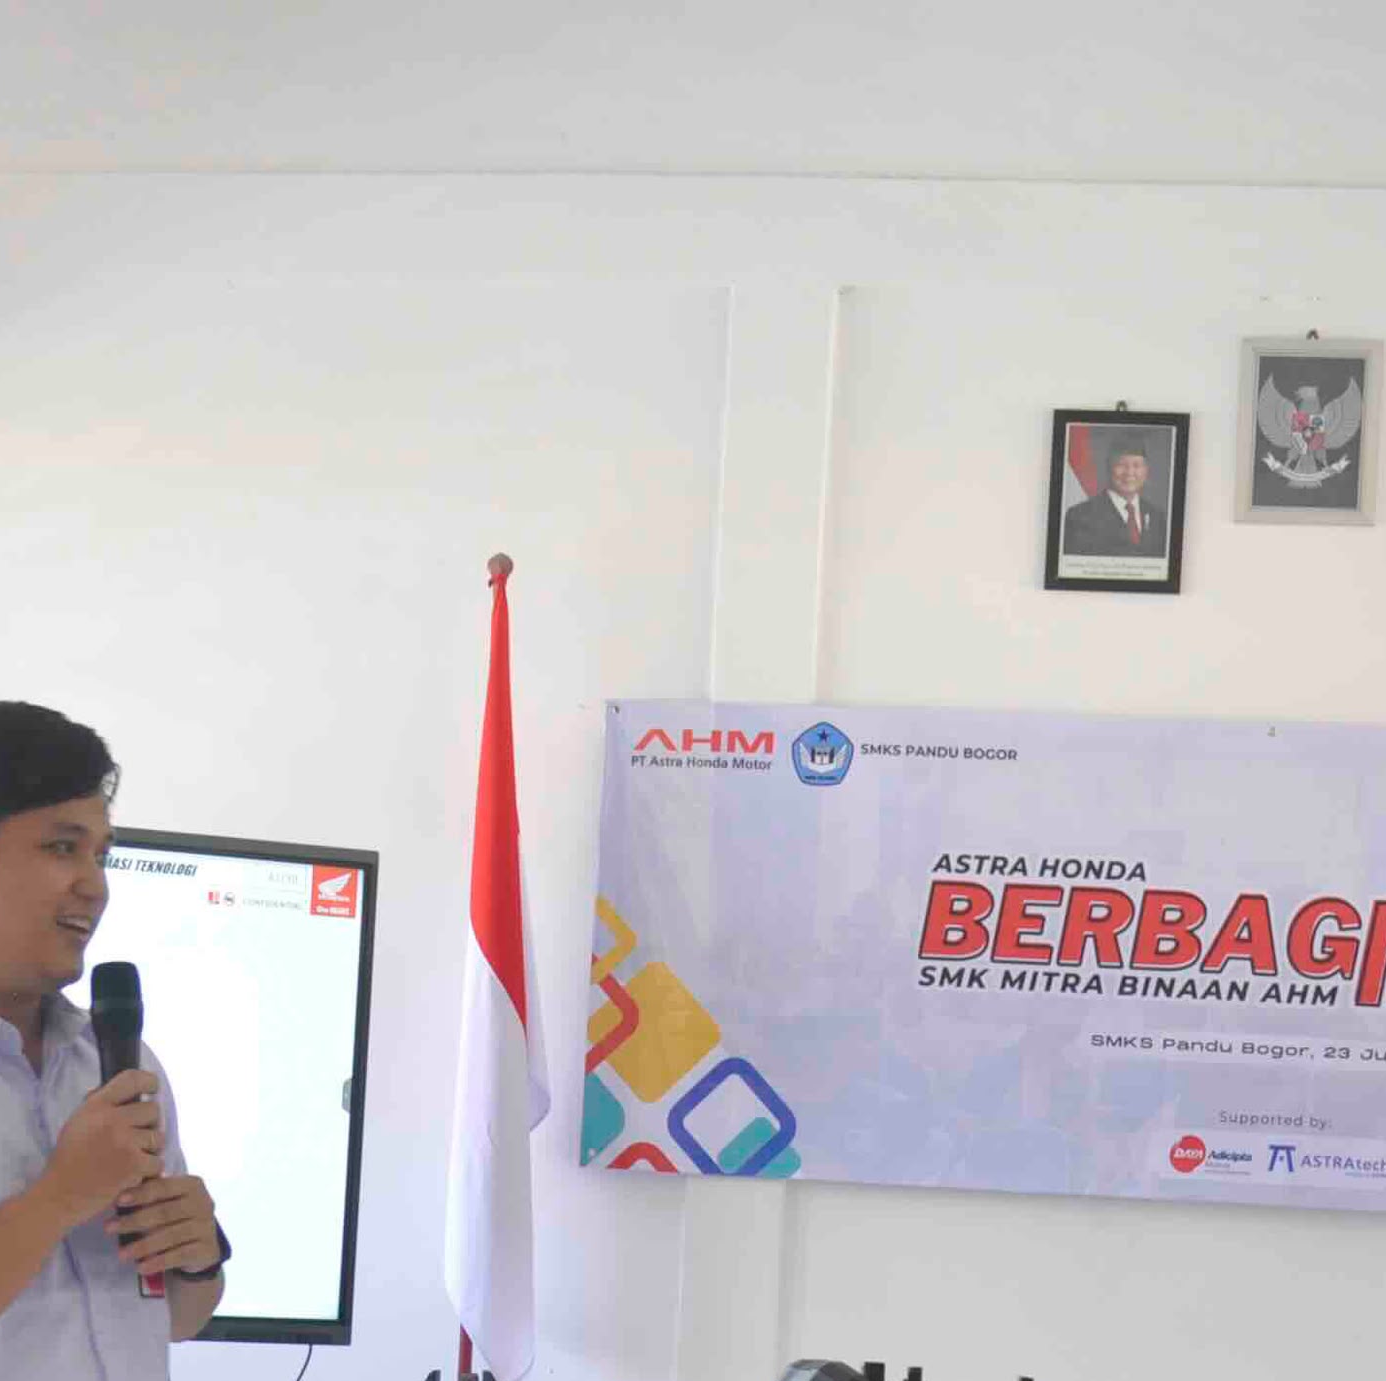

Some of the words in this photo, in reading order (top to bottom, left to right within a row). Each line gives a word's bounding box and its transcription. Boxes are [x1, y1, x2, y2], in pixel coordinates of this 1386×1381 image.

[633, 728, 775, 754] AHM
[860, 743, 901, 757] SMKS
[906, 745, 959, 759] PANDU
[964, 747, 1018, 761] BOGOR
[631, 755, 647, 767] PT
[649, 756, 683, 768] Astra
[687, 757, 728, 769] Honda
[732, 758, 772, 771] Motor
[135, 859, 199, 877] TEKNOLOGI
[931, 853, 1028, 877] ASTRA
[1039, 857, 1147, 882] HONDA
[918, 965, 989, 989] SMK
[1000, 969, 1104, 995] MITRA
[1118, 975, 1250, 1002] BINAAN
[1259, 982, 1339, 1006] AHM
[1090, 1034, 1154, 1049] SMKS
[1163, 1038, 1233, 1054] Pandu
[1241, 1042, 1315, 1060] Bogor,
[1323, 1046, 1351, 1060] 23
[1219, 1110, 1304, 1128] Supported
[1309, 1116, 1333, 1131] by:
